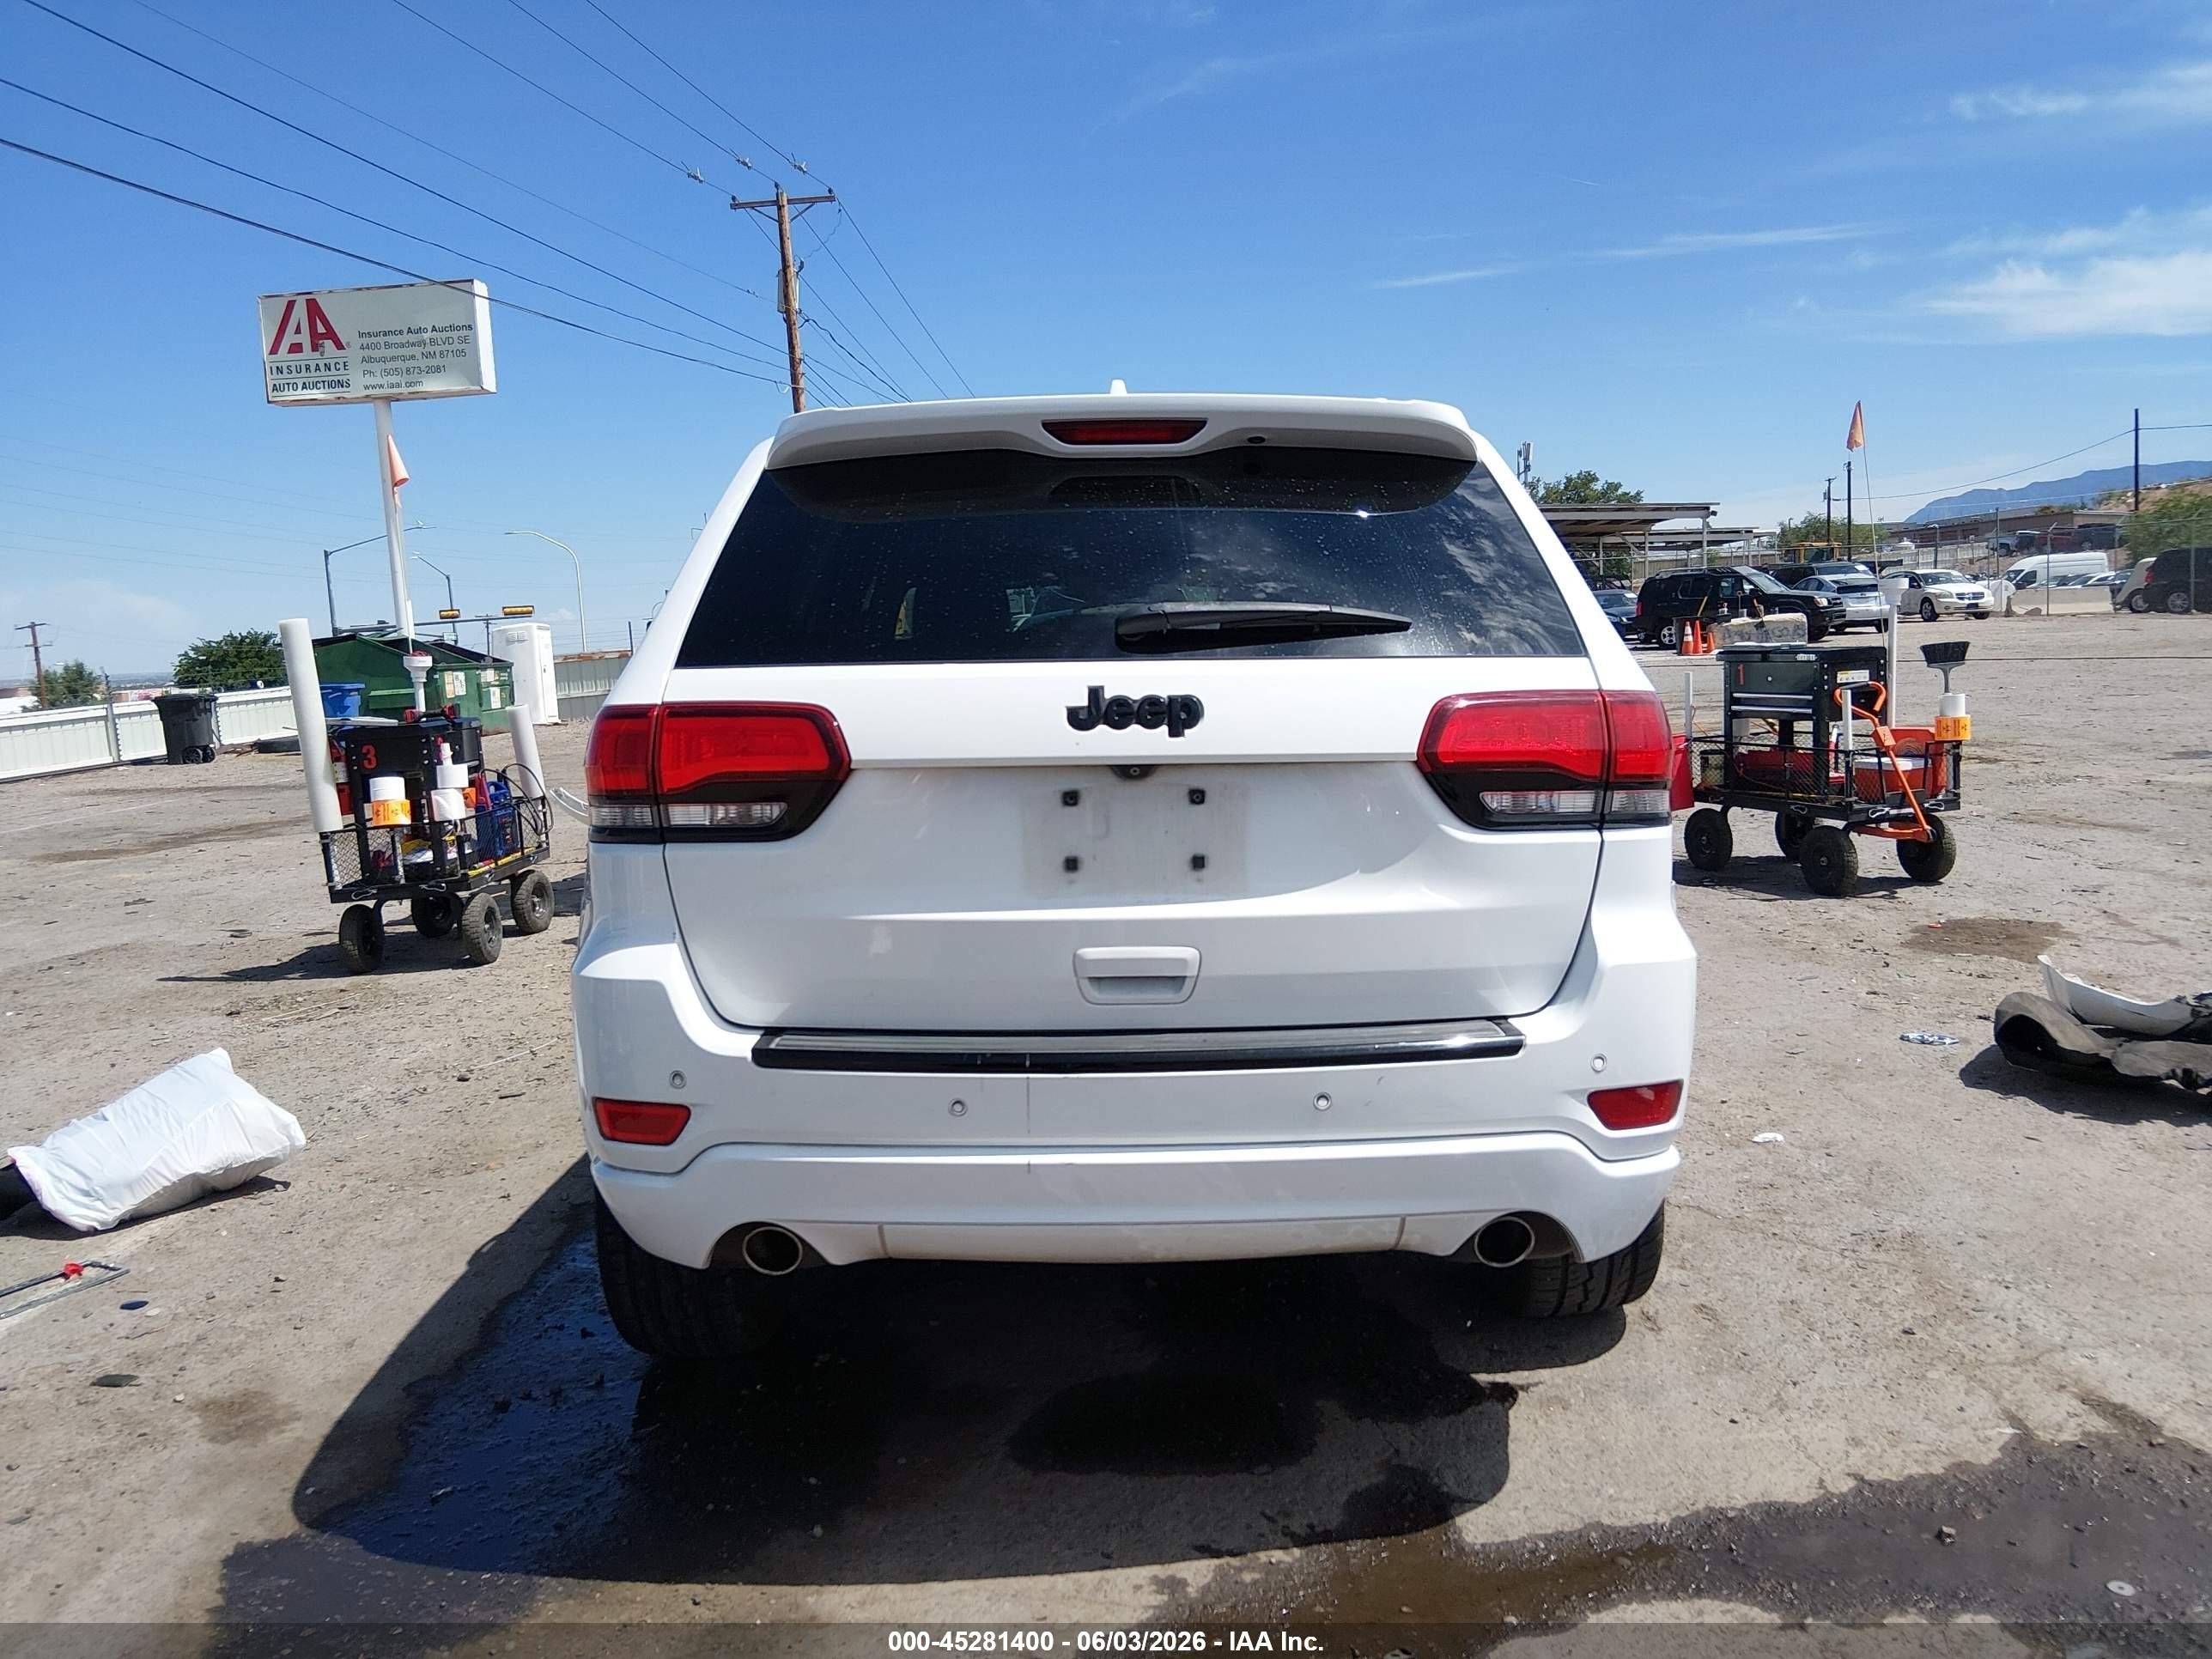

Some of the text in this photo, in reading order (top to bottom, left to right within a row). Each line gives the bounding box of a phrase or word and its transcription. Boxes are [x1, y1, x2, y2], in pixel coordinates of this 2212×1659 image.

[358, 323, 474, 339] Insurance Auto Auctions
[360, 335, 471, 351] 4400 Broadway BLVD SE
[361, 349, 467, 365] Albuquerque, NM 87105
[270, 361, 350, 375] INSURANCE
[362, 364, 447, 379] Ph: (505) 873-2081
[271, 378, 351, 392] AUTO AUCTIONS
[363, 380, 423, 391] www.iaai.com
[1066, 685, 1204, 738] Jeep
[362, 744, 378, 770] 3
